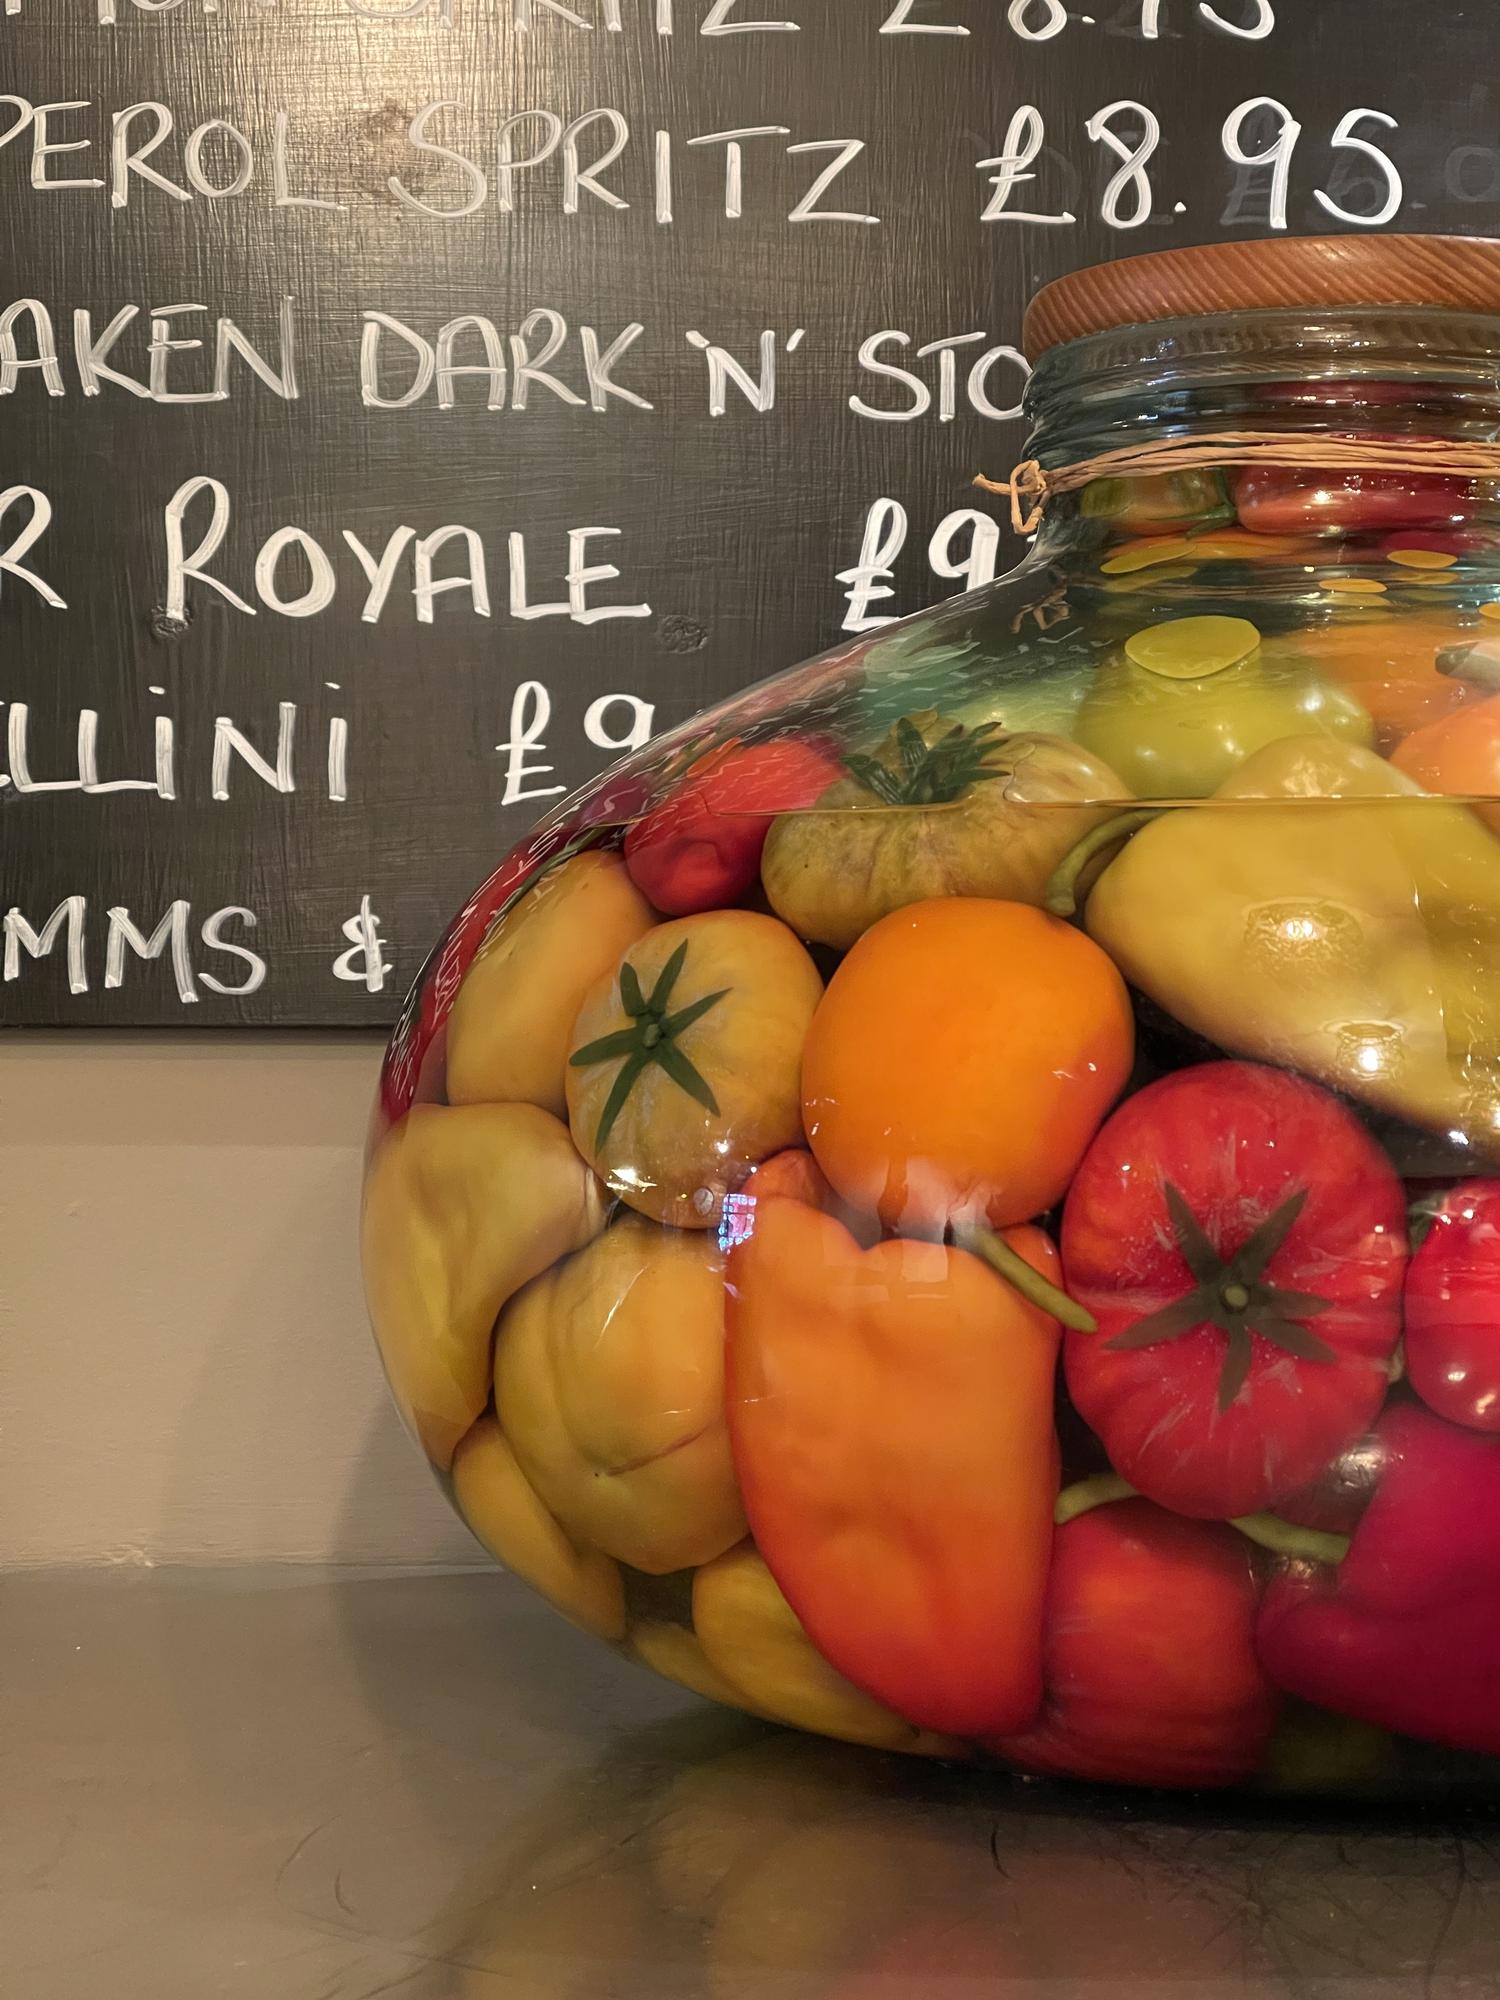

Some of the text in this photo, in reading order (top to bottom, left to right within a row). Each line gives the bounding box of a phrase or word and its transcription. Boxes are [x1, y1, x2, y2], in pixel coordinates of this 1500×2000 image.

[388, 101, 881, 224] SPRITZ
[975, 96, 1403, 229] £8.95
[0, 294, 300, 402] AKEN
[361, 308, 654, 412] DARK
[165, 475, 652, 625] ROYALE
